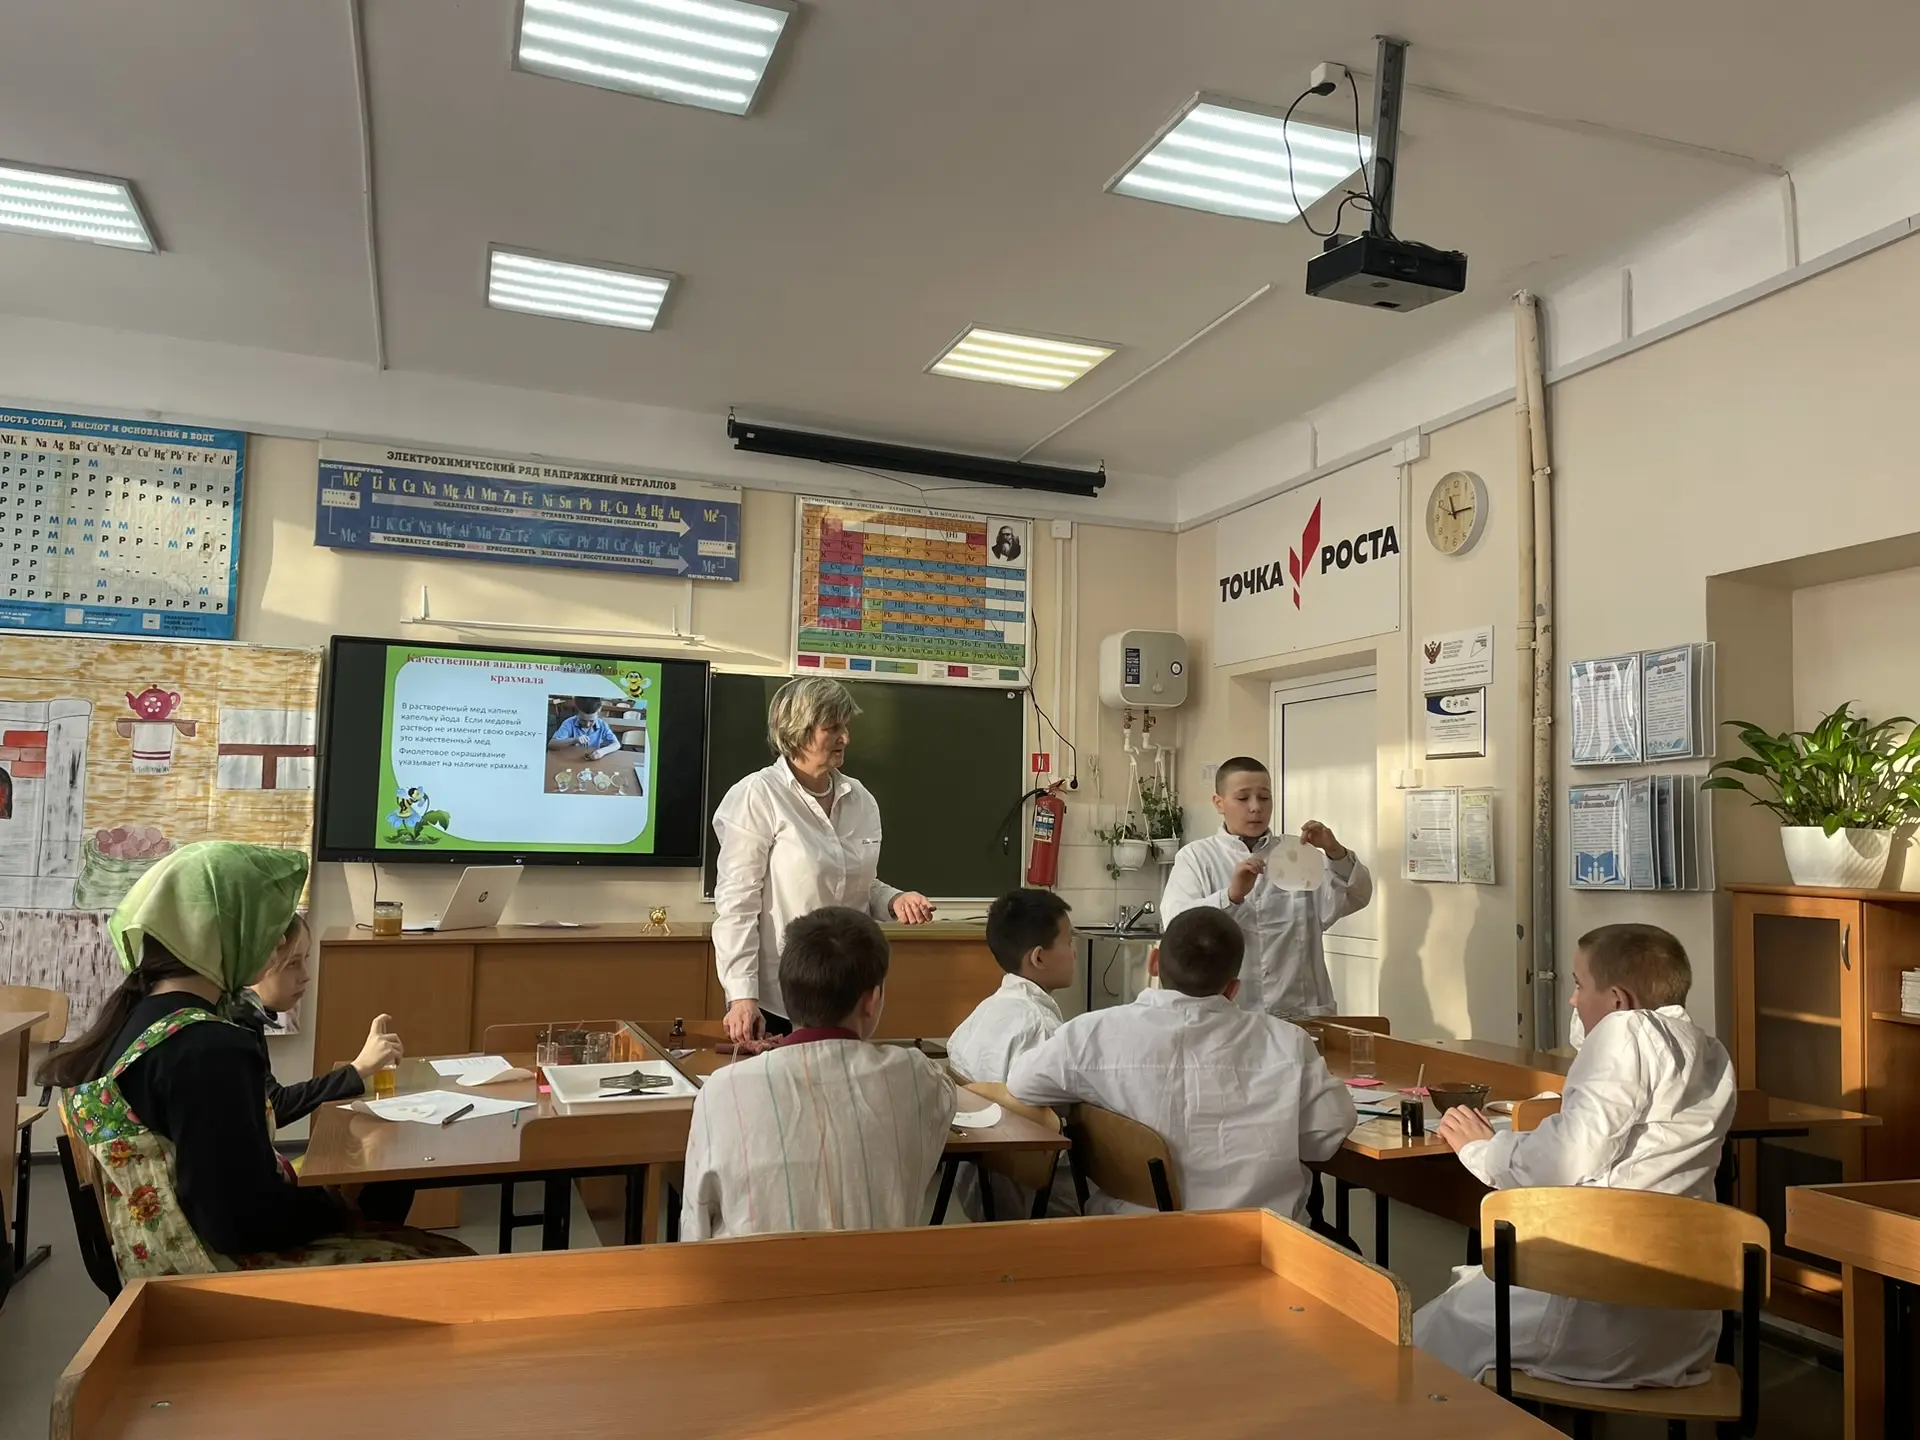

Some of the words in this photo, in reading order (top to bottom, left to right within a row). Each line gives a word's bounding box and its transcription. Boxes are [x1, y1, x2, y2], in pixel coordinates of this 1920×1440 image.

[31, 418, 67, 429] СОЛЕЙ,
[71, 421, 111, 431] КИСЛОТ
[121, 426, 179, 438] ОСНОВАНИЙ
[191, 433, 215, 442] ВОДЕ
[3, 451, 11, 459] Р
[21, 453, 28, 461] Р
[38, 455, 46, 463] Р
[88, 459, 98, 467] М
[387, 451, 516, 473] ЭЛЕКТРОХИМИЧЕСКИЙ
[518, 465, 541, 478] РЯД
[543, 468, 619, 485] НАПРЯЖЕНИЙ
[620, 477, 677, 490] МЕТАЛЛОВ
[2, 466, 10, 474] Р
[20, 468, 27, 476] Р
[37, 470, 44, 478] Р
[54, 471, 62, 479] Р
[89, 474, 96, 482] Р
[123, 477, 130, 485] Р
[156, 480, 164, 488] Р
[190, 483, 197, 491] Р
[223, 486, 230, 494] Р
[372, 475, 382, 490] Li
[389, 477, 396, 491] K
[402, 479, 416, 493] Ca
[422, 481, 436, 495] Na
[443, 484, 459, 500] Mg
[464, 486, 475, 499] Al
[481, 487, 497, 502] Mn
[503, 490, 516, 503] Zn
[523, 492, 534, 505] Fe
[543, 494, 553, 507] Ni
[559, 496, 572, 509] Sn
[579, 497, 592, 511] Pb
[616, 501, 628, 514] Cu
[635, 503, 647, 519] Ag
[651, 504, 664, 521] Hg
[668, 506, 681, 519] Au
[481, 505, 514, 514] СВОЙСТВО
[431, 540, 466, 549] СВОЙСТВО
[1220, 561, 1284, 602] ТОЧКА
[1321, 525, 1400, 575] РОСТА
[9, 588, 17, 596] Р
[27, 590, 35, 598] Р
[45, 591, 52, 599] Р
[63, 592, 70, 600] Р
[80, 593, 88, 601] Р
[132, 597, 139, 605] Р
[149, 598, 156, 606] Р
[166, 599, 173, 607] Р
[183, 600, 190, 608] Р
[200, 601, 207, 609] Р
[493, 661, 532, 670] анализ
[535, 663, 560, 672] меда
[490, 674, 544, 685] крахмала
[409, 703, 468, 712] растворенный
[401, 714, 439, 722] капельку
[485, 718, 521, 726] медовый
[505, 730, 537, 738] окраску
[414, 736, 472, 744] качественный
[399, 747, 449, 756] Фиолетовое
[451, 750, 506, 758] окрашивание
